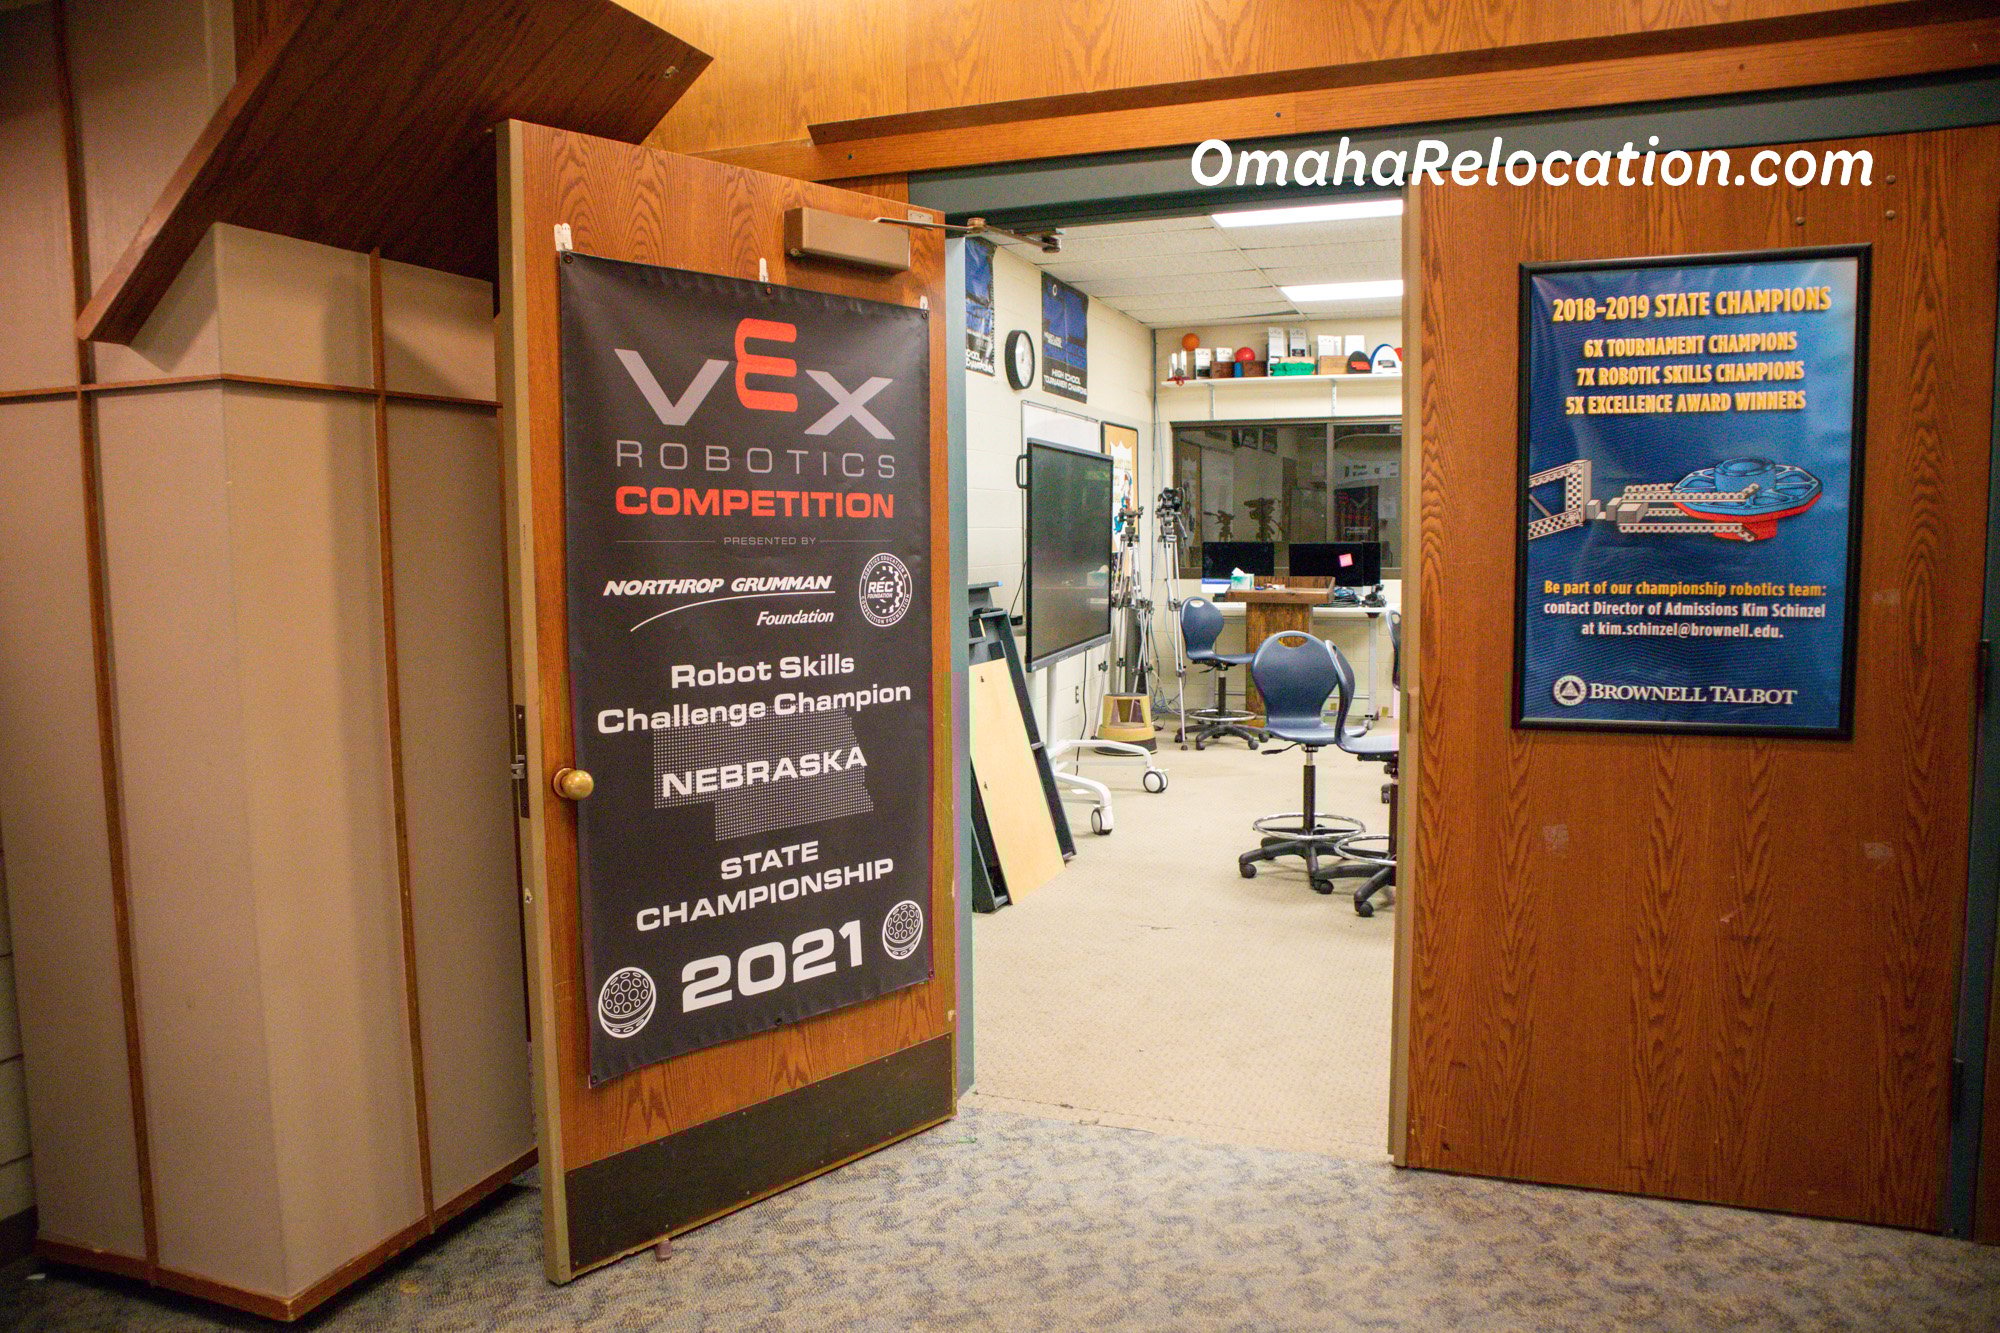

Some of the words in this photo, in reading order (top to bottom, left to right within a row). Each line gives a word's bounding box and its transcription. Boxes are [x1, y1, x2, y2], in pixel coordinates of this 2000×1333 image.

[1552, 295, 1650, 322] 2018-2019
[1654, 292, 1710, 318] STATE
[1715, 287, 1832, 315] CHAMPIONS
[1583, 339, 1603, 358] 6X
[1606, 335, 1705, 357] TOURNAMENT
[1709, 332, 1797, 354] CHAMPIONS
[614, 318, 895, 440] VEX
[1576, 368, 1595, 386] 7X
[1598, 366, 1660, 385] ROBOTIC
[1663, 364, 1712, 384] SKILLS
[1715, 361, 1805, 383] CHAMPIONS
[1565, 397, 1585, 415] 5X
[1587, 395, 1673, 414] EXCELLENCE
[1676, 393, 1731, 413] AWARD
[1735, 391, 1806, 411] WINNERS
[616, 439, 896, 479] ROBOTICS
[615, 485, 894, 519] COMPETITION
[723, 536, 797, 546] PRESENTED
[800, 536, 816, 545] BY
[603, 579, 724, 596] NORTHROP
[731, 575, 833, 593] GRUMMAN
[868, 581, 894, 593] REC
[1544, 580, 1561, 594] Be
[1563, 581, 1592, 596] part
[1594, 581, 1608, 594] of
[1610, 584, 1633, 595] our
[1635, 582, 1727, 598] championship
[1729, 582, 1785, 596] robotics
[1788, 584, 1827, 597] team:
[756, 609, 834, 626] Foundation
[1544, 602, 1590, 615] contact
[1594, 602, 1644, 616] Director
[1647, 602, 1663, 616] of
[1665, 602, 1739, 617] Admissions
[1741, 603, 1768, 617] Kim
[1772, 603, 1826, 618] Schinzel
[1581, 624, 1595, 635] at
[1598, 623, 1784, 639] kim.schinzel@brownell.edu.
[671, 660, 772, 688] Robot
[779, 653, 855, 678] Skills
[1590, 682, 1707, 702] BROWNELL
[1710, 685, 1797, 704] TALBOT
[597, 699, 766, 734] Challenge
[773, 685, 911, 716] Champion
[662, 746, 867, 798] NEBRASKA
[720, 840, 819, 881] STATE
[636, 857, 894, 932] CHAMPIONSHIP
[681, 919, 863, 1013] 2021
